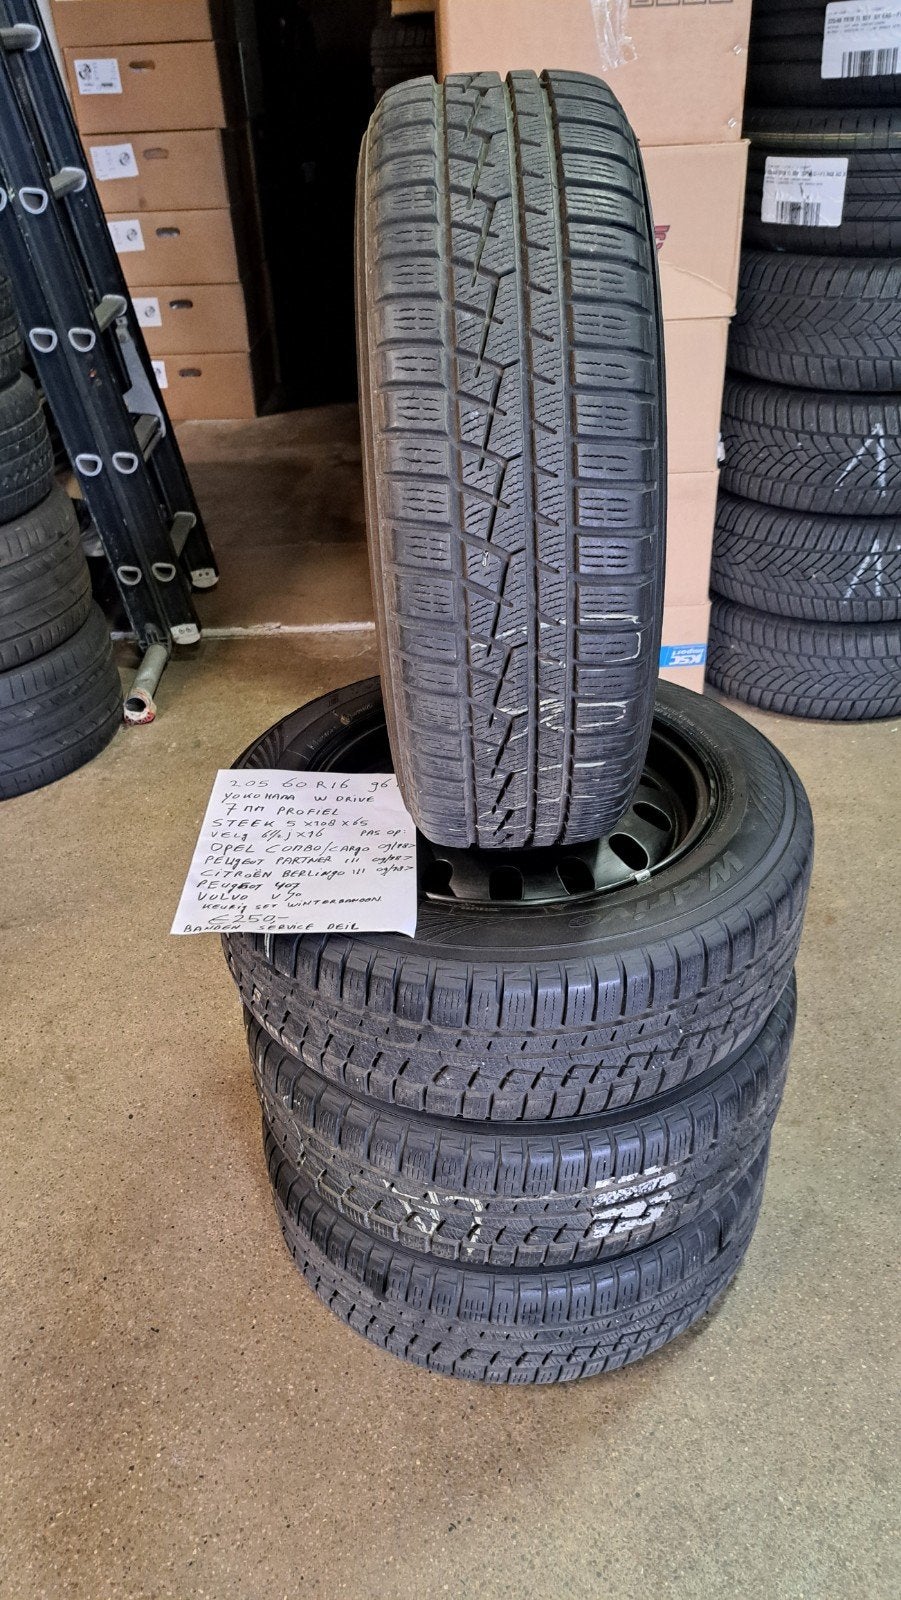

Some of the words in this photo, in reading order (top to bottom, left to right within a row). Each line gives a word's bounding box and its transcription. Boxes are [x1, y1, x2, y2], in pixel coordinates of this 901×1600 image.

[229, 779, 270, 788] 205
[282, 777, 308, 788] 60
[316, 778, 351, 789] R16
[225, 802, 238, 816] 7
[212, 818, 275, 827] STEEK
[360, 829, 381, 837] PAS
[276, 855, 333, 865] PARTNER
